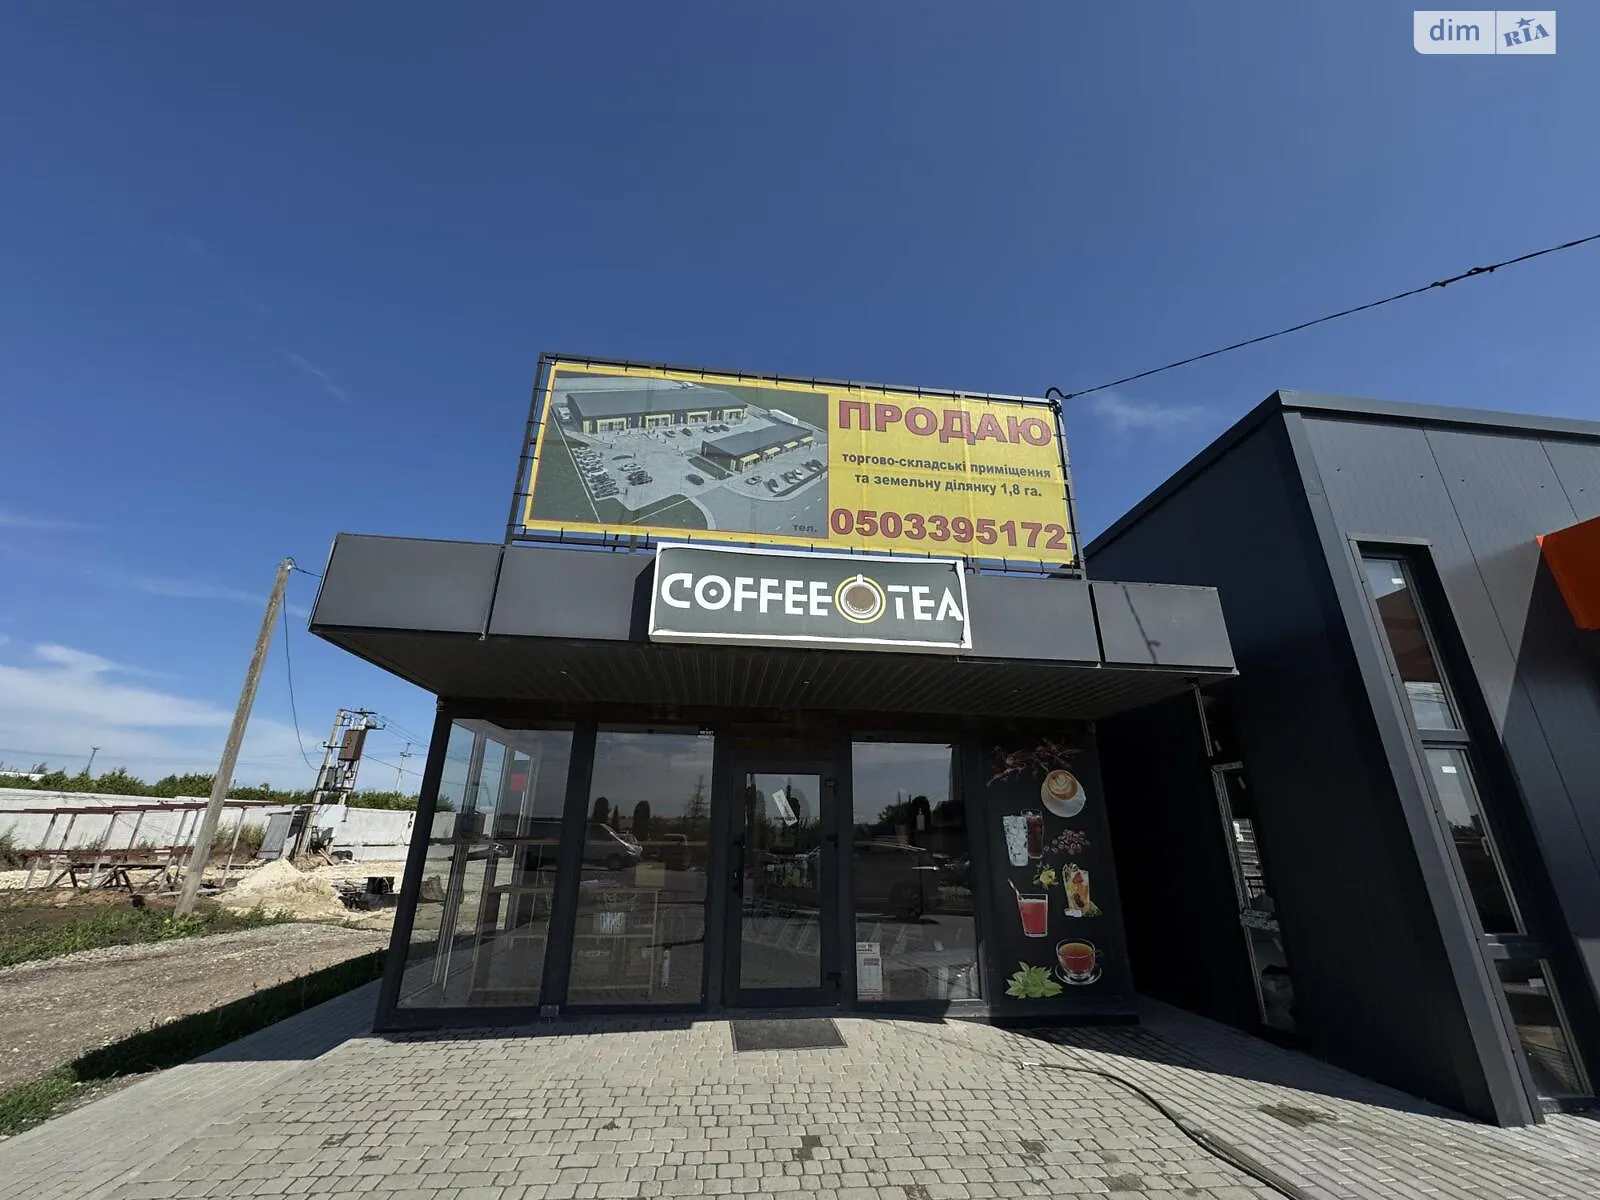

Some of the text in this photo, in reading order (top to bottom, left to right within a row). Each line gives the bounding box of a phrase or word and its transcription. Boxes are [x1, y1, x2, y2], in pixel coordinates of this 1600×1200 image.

[838, 400, 1052, 447] ПРОДАЮ
[842, 452, 1051, 479] торгово-складські приміщення
[854, 473, 1042, 497] та земельну ділянку 1,8 га.
[791, 508, 1068, 550] тел. 0503395172
[660, 572, 964, 622] COFFEE TEA
